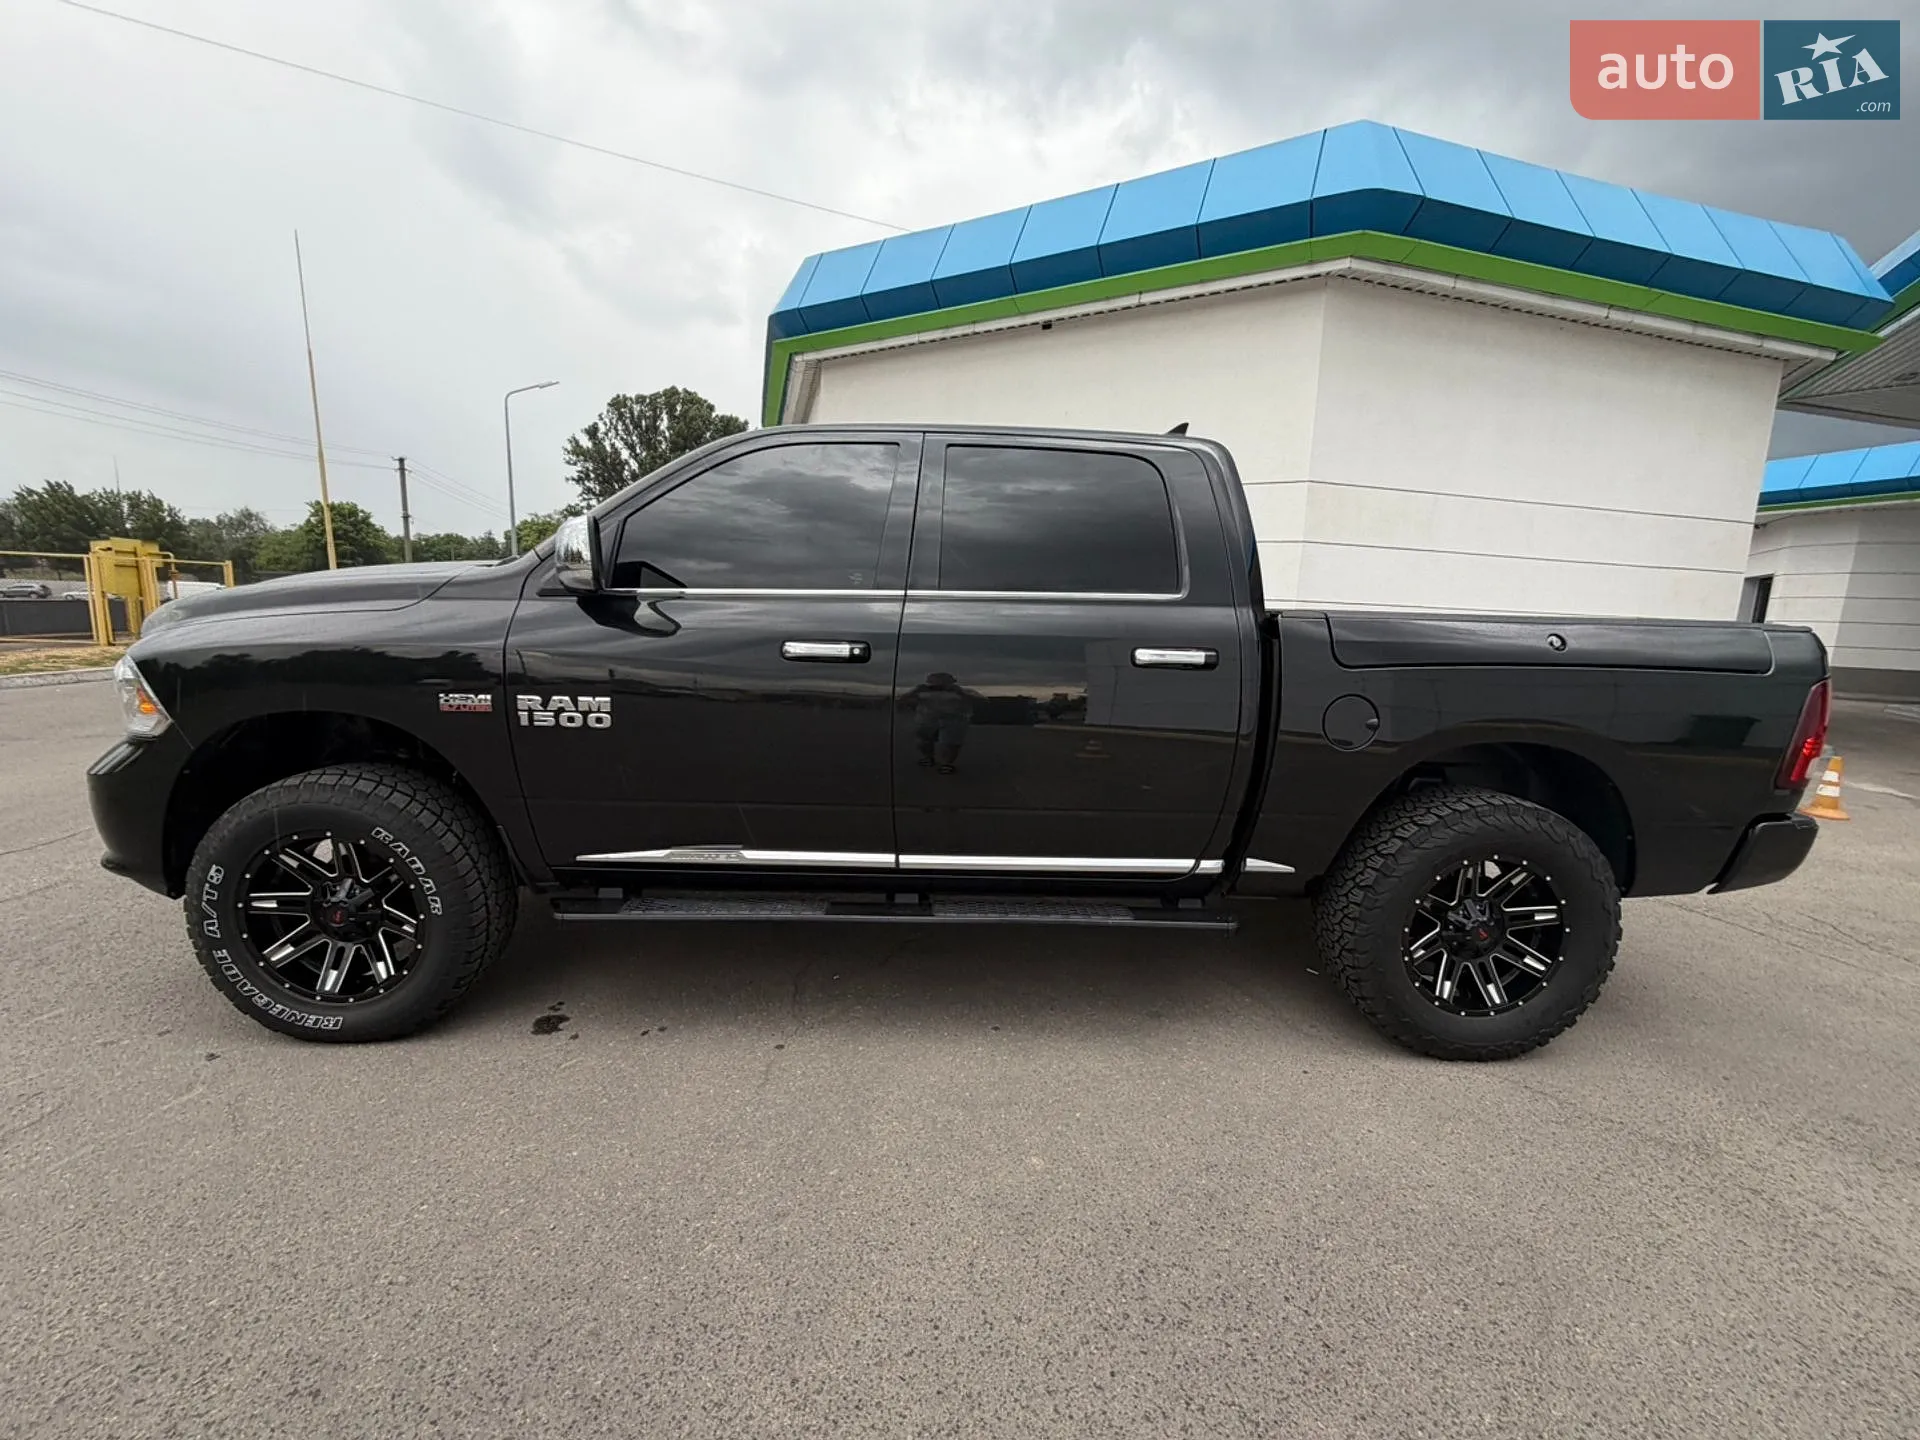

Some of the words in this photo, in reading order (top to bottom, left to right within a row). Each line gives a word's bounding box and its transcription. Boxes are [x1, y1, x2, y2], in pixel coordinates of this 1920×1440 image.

[438, 693, 492, 704] HEMI
[516, 694, 611, 711] RAM
[518, 712, 612, 729] 1500
[371, 827, 443, 915] RADAR
[212, 949, 343, 1030] RENEGADE
